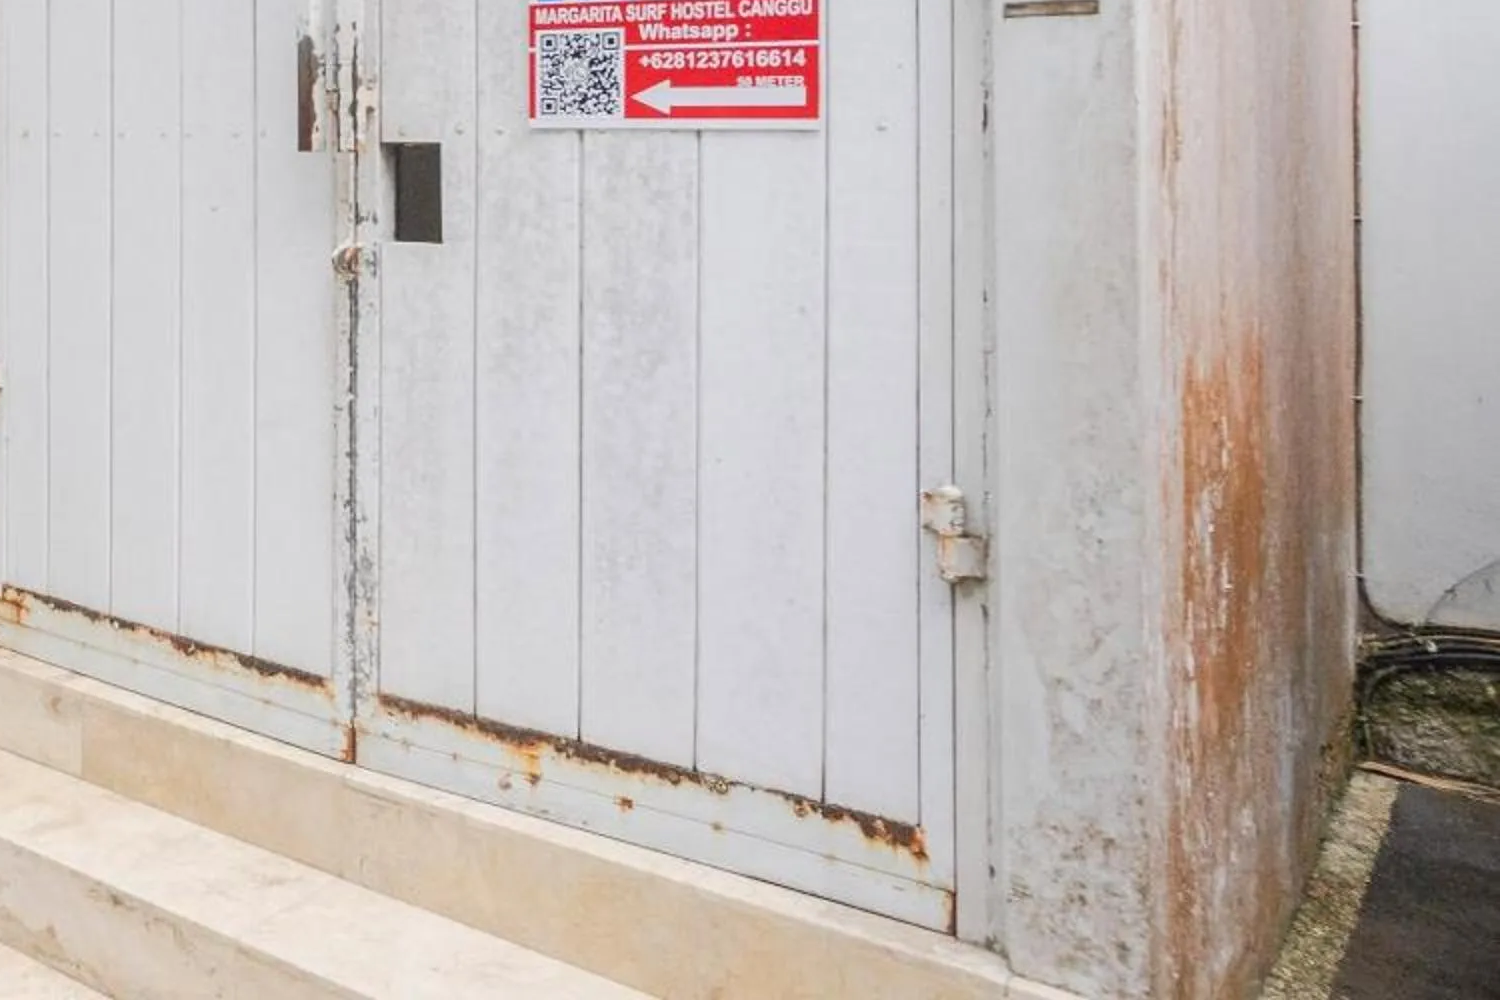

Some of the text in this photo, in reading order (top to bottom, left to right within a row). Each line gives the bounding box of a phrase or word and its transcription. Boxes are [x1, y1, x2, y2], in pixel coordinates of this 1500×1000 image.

[535, 4, 624, 25] MARGARITA
[625, 2, 668, 23] SURF
[671, 0, 735, 21] HOSTEL
[638, 21, 739, 41] Whatsapp
[638, 49, 806, 69] +6281237616614
